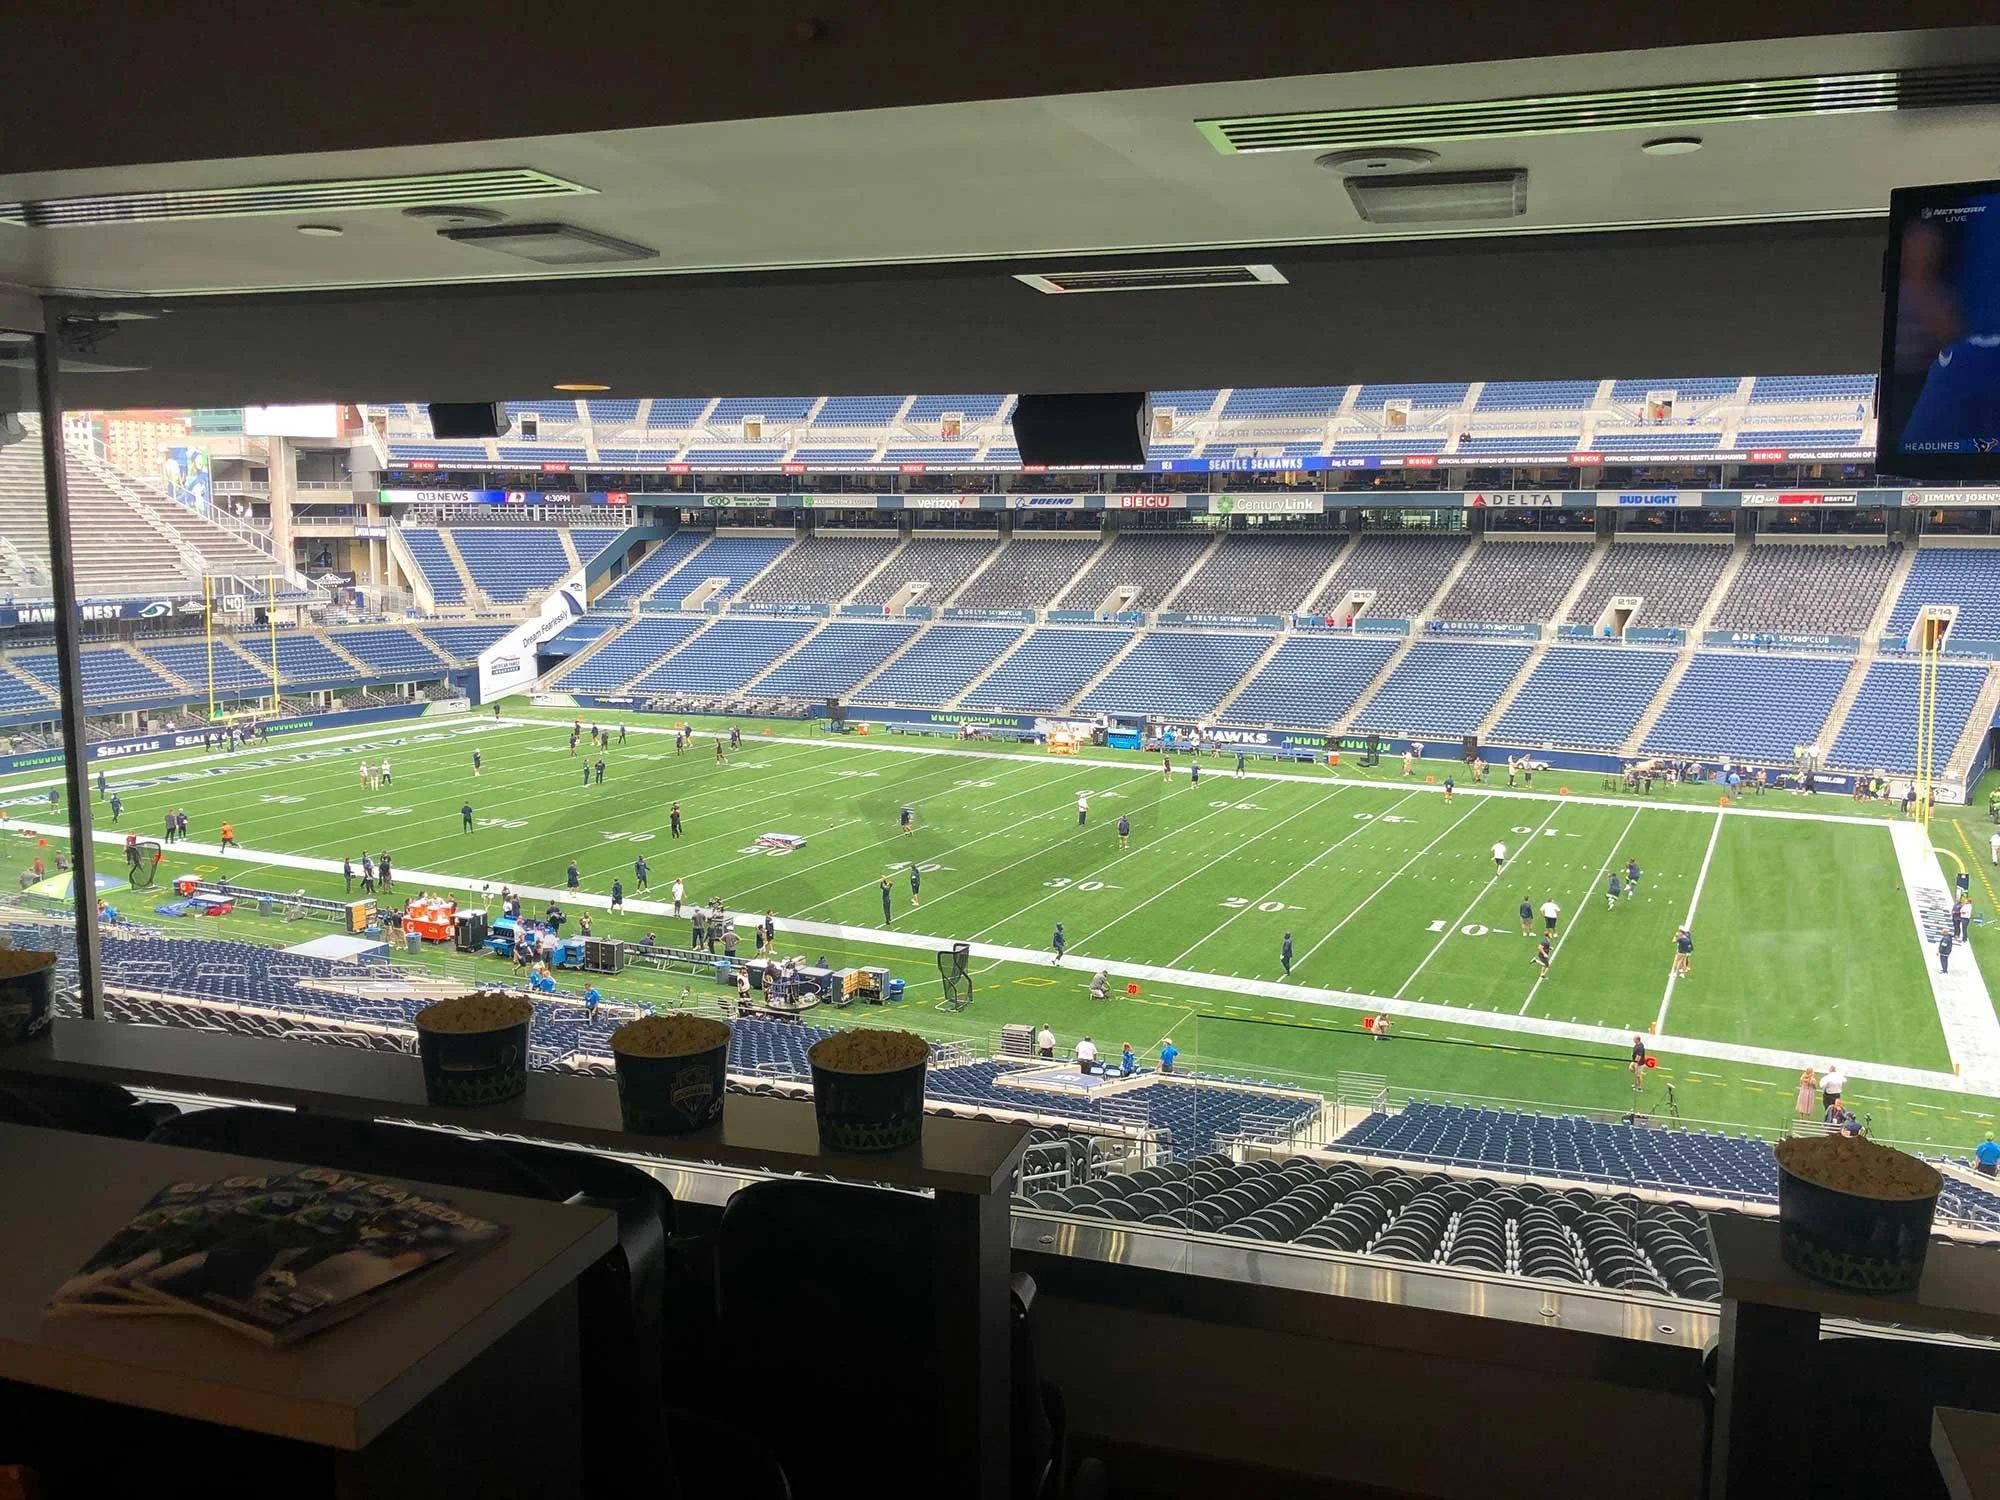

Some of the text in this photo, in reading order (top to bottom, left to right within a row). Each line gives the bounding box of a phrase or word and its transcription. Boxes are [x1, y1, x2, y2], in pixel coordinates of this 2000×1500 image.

[1933, 205, 1986, 216] NETWORK
[1904, 441, 1960, 451] HEADLINES
[1162, 461, 1172, 470] SEA
[1208, 458, 1303, 470] SEATTLE SEAHAWKS
[416, 493, 436, 501] Q13
[1122, 496, 1168, 507] BECU
[1493, 495, 1552, 505] DELTA
[1620, 496, 1677, 504] BUD LIGHT
[1743, 495, 1764, 504] 710
[918, 498, 960, 508] verizon
[1237, 498, 1313, 511] CenturyLink
[18, 605, 122, 622] HAW NEST
[523, 610, 568, 648] Dream Fearlessly
[97, 741, 160, 757] SEATTLE
[1043, 878, 1104, 891] 30
[1218, 897, 1285, 912] 20
[1425, 920, 1489, 936] 10
[1128, 984, 1136, 993] 20
[1365, 1018, 1374, 1028] 10
[1646, 1058, 1656, 1068] G
